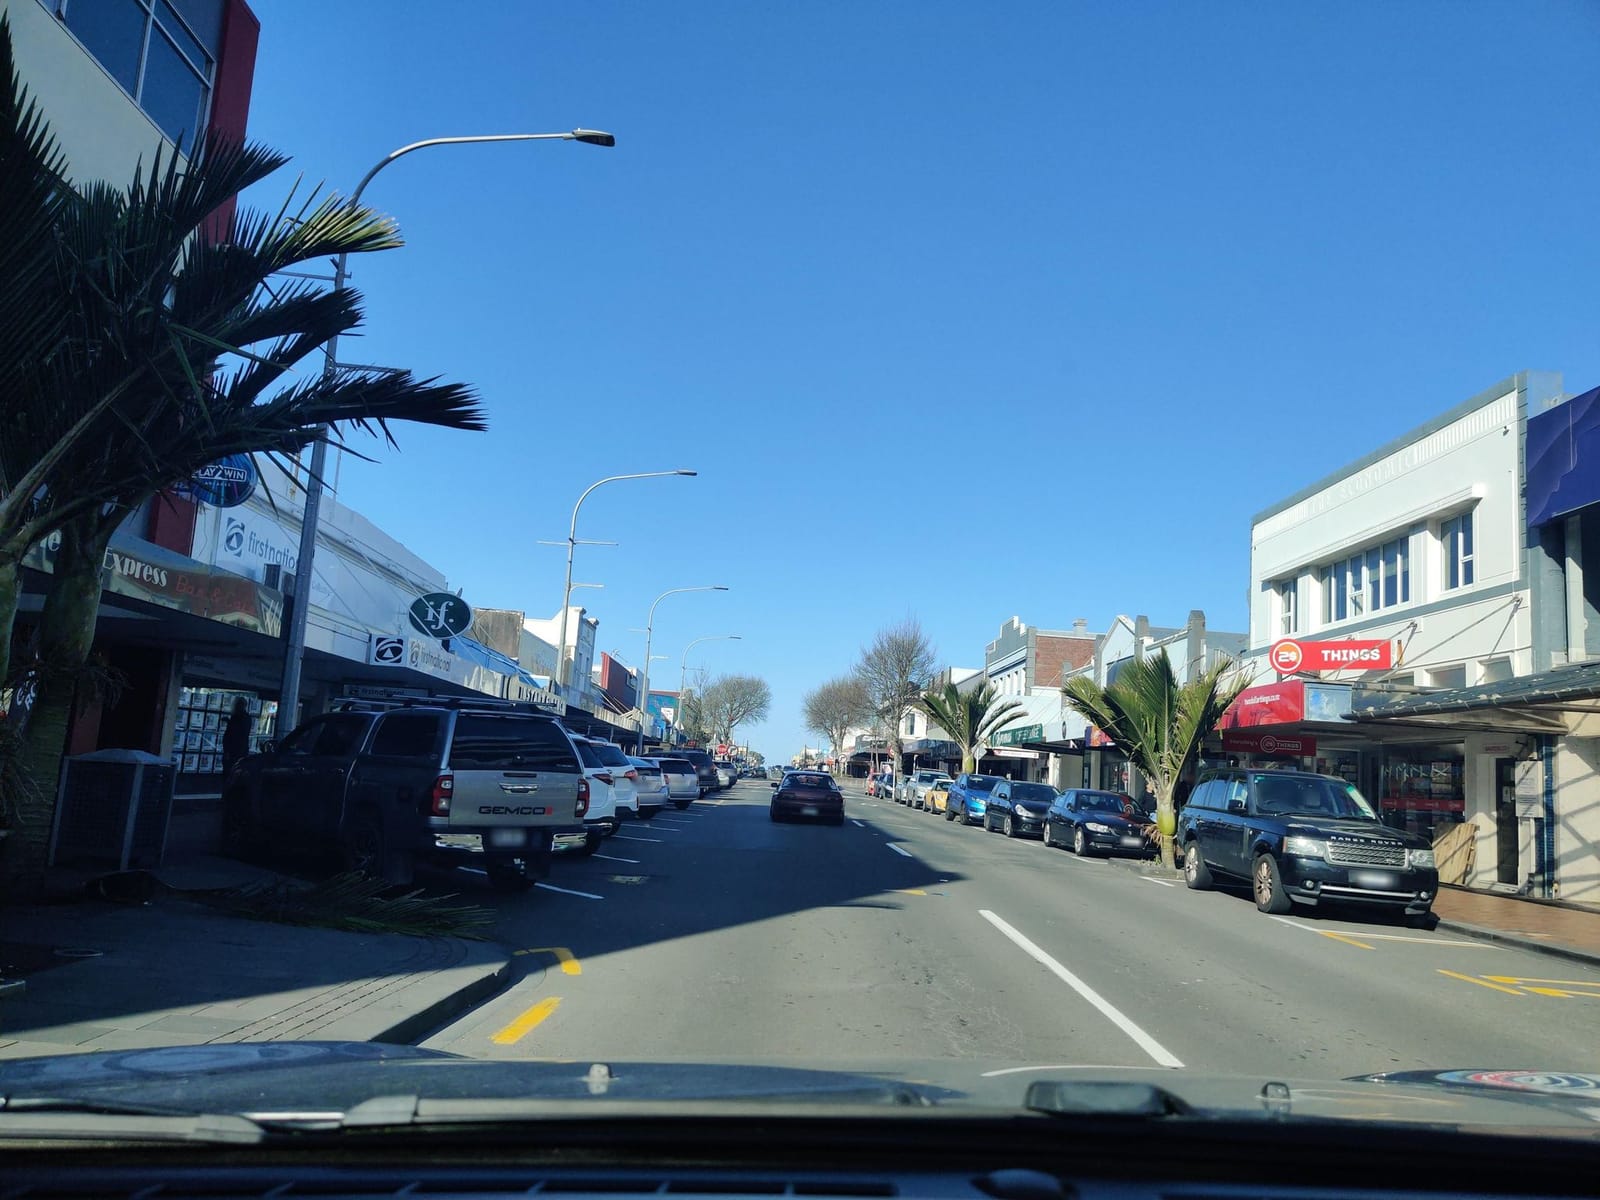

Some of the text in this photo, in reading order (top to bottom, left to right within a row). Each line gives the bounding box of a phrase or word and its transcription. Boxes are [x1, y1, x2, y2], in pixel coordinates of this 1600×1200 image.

[194, 465, 245, 480] LAY2WIN
[248, 531, 297, 569] firstnatio
[103, 547, 168, 587] Express
[1321, 648, 1381, 662] THINGS
[478, 806, 546, 815] GEMCO
[1330, 835, 1365, 843] RANGE
